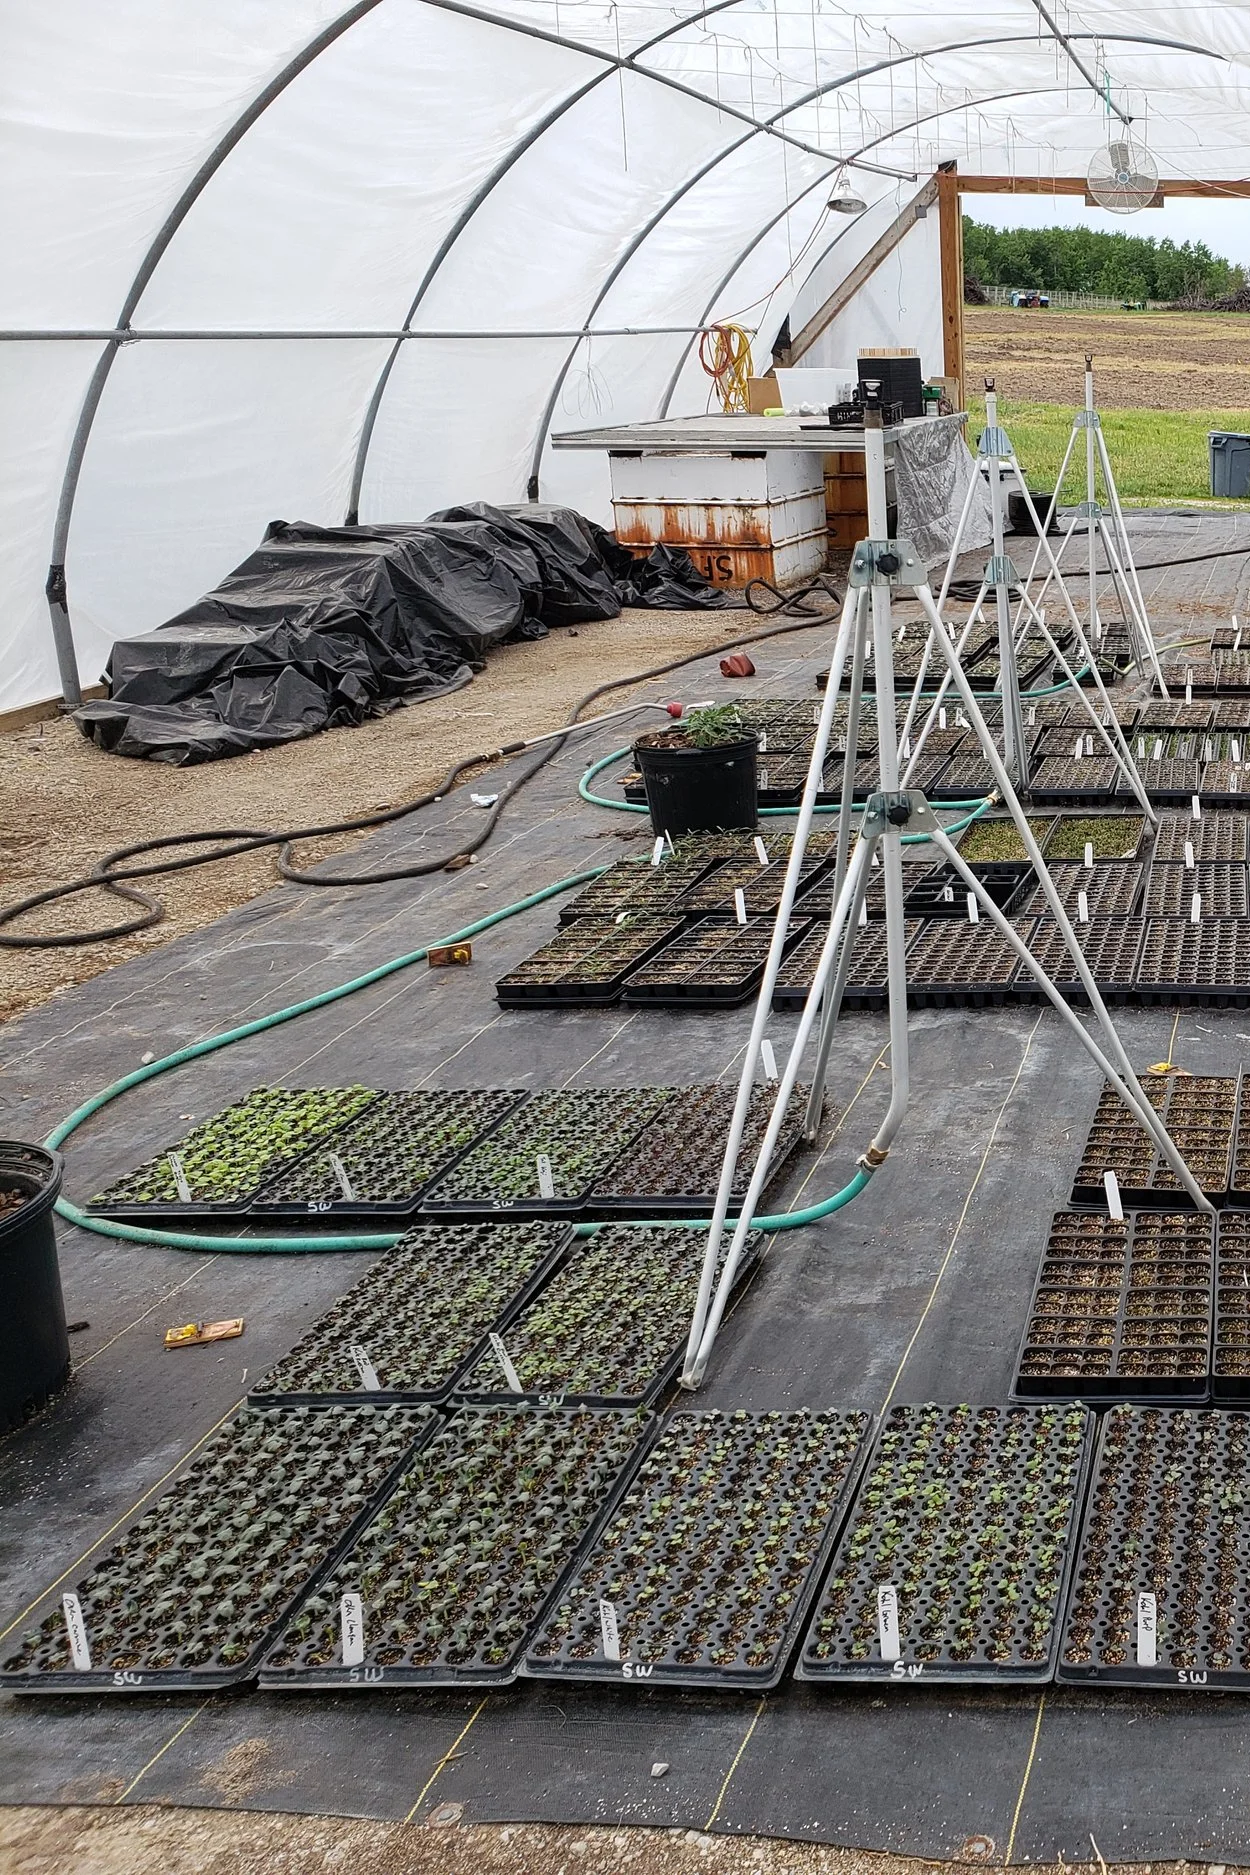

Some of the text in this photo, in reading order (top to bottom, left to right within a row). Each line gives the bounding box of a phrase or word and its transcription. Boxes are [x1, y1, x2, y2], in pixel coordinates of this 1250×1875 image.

[307, 1201, 332, 1213] SW
[492, 1199, 514, 1210] SW
[621, 1662, 654, 1678] SW
[890, 1660, 923, 1679] SW
[113, 1671, 142, 1686] SW
[1177, 1670, 1208, 1684] SW
